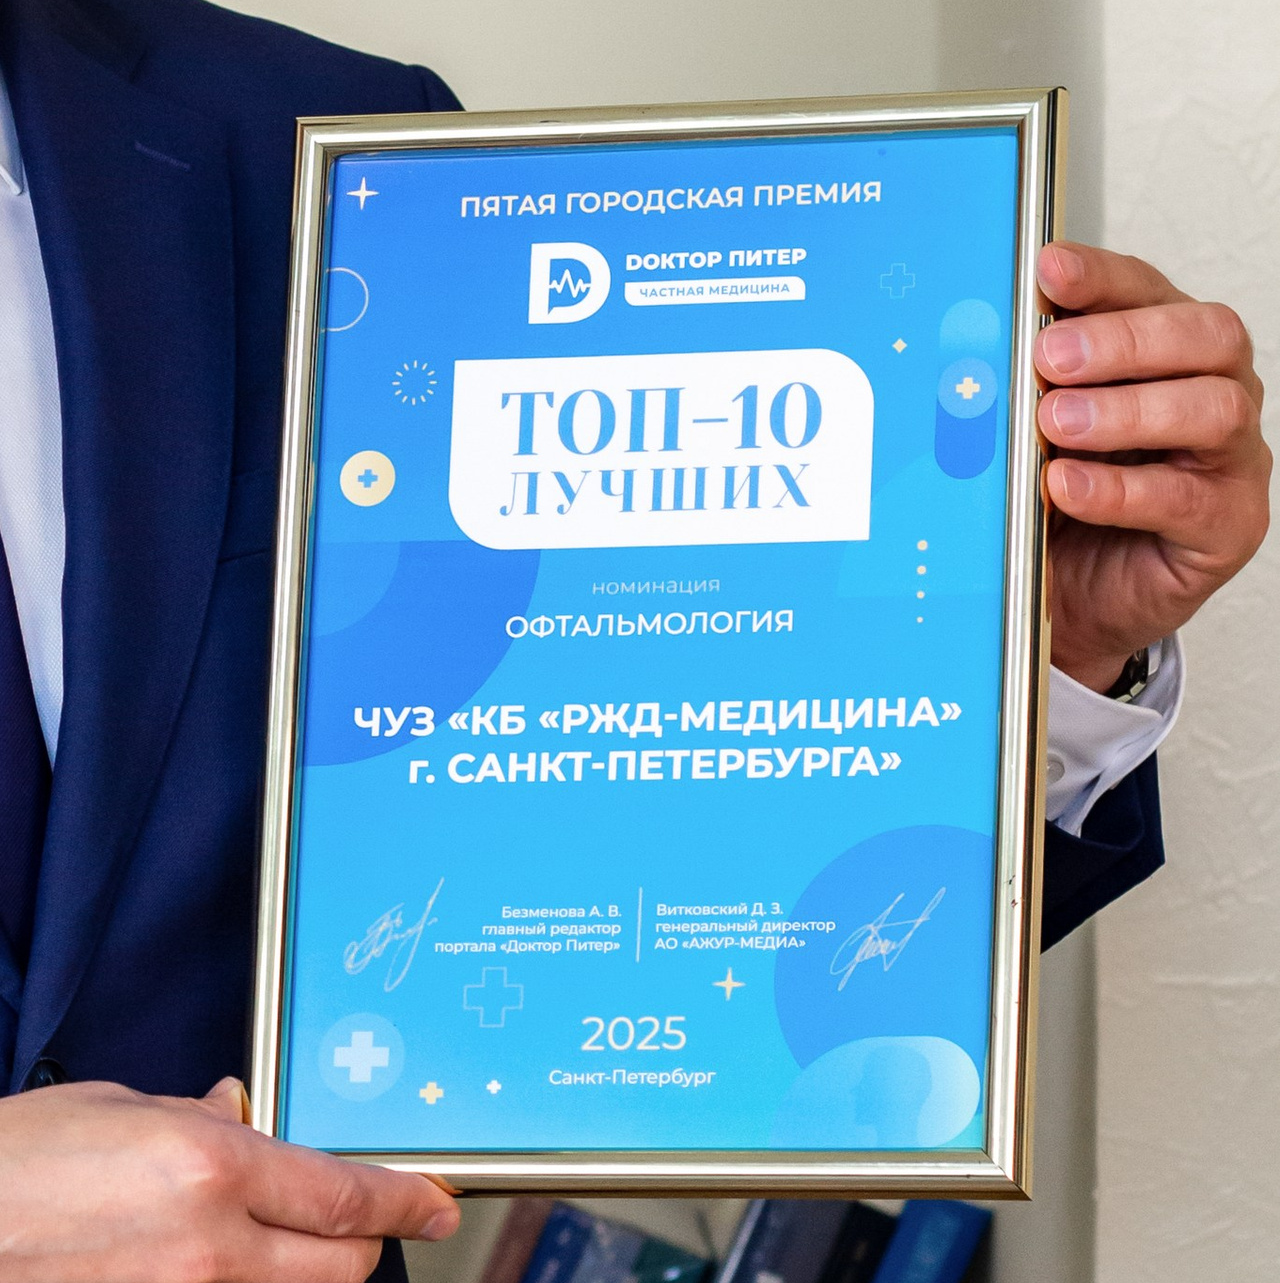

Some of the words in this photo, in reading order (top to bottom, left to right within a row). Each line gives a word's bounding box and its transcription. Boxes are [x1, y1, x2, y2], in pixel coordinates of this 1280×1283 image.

[461, 194, 555, 217] ПЯТАЯ
[567, 187, 743, 214] ГОРОДСКАЯ
[754, 181, 881, 206] ПРЕМИЯ
[729, 248, 806, 266] ПИТЕР
[639, 286, 704, 298] ЧАСТНАЯ
[709, 283, 790, 296] МЕДИЦИНА
[502, 383, 822, 455] ТОП-10
[500, 464, 809, 516] ЛУЧШИХ
[593, 580, 720, 595] номинация
[506, 610, 793, 638] ОФТАЛЬМОЛОГИЯ
[354, 706, 435, 737] ЧУЗ
[448, 705, 526, 735] «КБ
[539, 697, 962, 738] «РЖД-МЕДИЦИНА»
[409, 760, 435, 783] г.
[448, 747, 901, 783] САНКТ-ПЕТЕРБУРГА»
[502, 906, 585, 918] Безменова
[589, 906, 604, 917] А.
[608, 905, 621, 917] В.
[657, 902, 747, 916] Витковский
[751, 903, 766, 916] Д.
[771, 902, 783, 914] З.
[482, 922, 546, 936] главный
[550, 923, 621, 937] редактор
[656, 920, 757, 934] генеральный
[761, 921, 836, 934] директор
[435, 942, 496, 955] портала
[500, 939, 562, 954] «Доктор
[566, 938, 620, 954] Питер»
[655, 938, 678, 949] АО
[682, 936, 805, 950] «АЖУР-МЕДИА»
[581, 1016, 686, 1051] 2025
[549, 1068, 716, 1087] Санкт-Петербург
